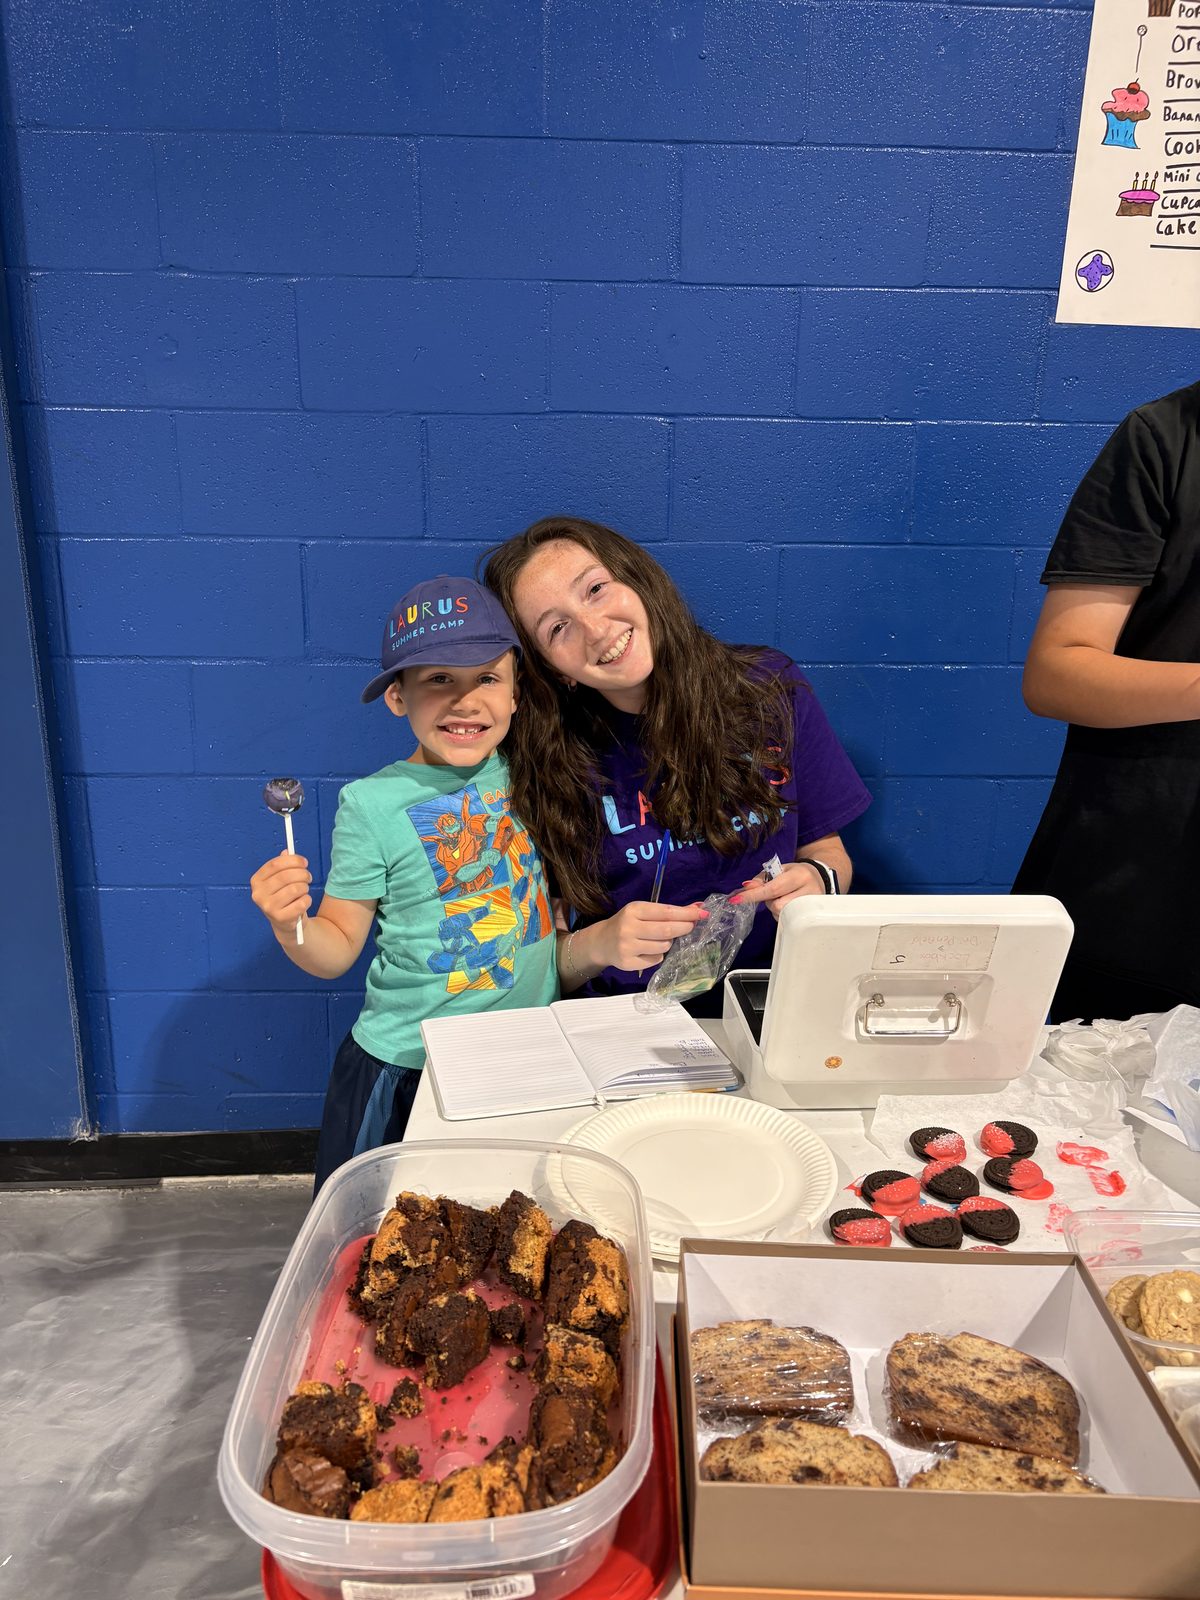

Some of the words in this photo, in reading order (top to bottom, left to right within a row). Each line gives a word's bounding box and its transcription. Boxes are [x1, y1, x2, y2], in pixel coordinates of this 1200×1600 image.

[1163, 169, 1190, 182] Mini
[1156, 219, 1196, 236] Cake
[389, 596, 470, 639] LAURUS
[392, 627, 425, 651] SUMMER
[430, 619, 465, 632] CAMP
